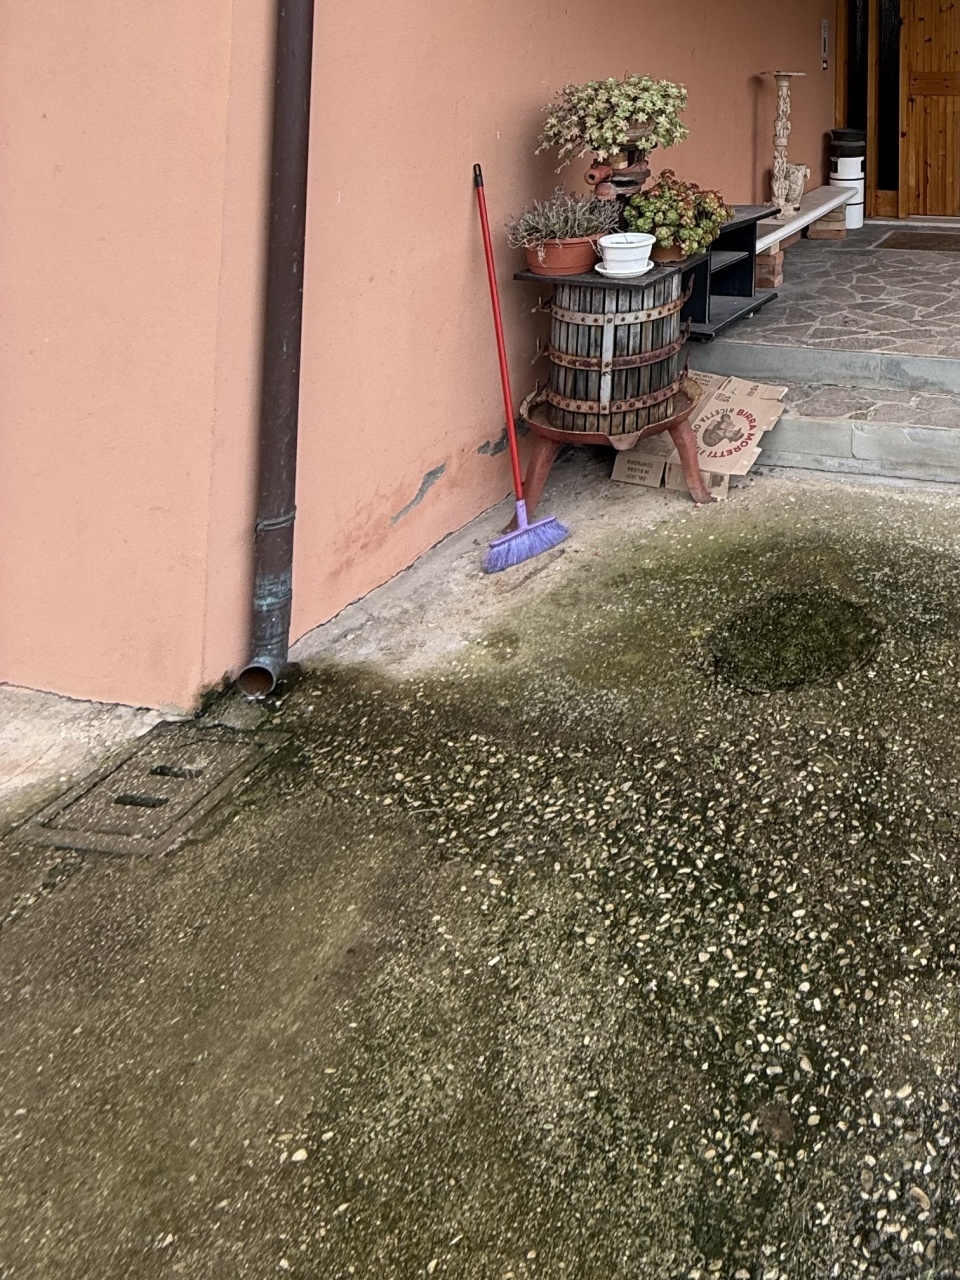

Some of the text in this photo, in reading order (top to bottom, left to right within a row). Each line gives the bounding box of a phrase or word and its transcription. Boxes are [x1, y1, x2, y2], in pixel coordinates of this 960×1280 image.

[700, 407, 735, 423] RICETTA
[707, 408, 757, 458] BIRRA MORETTI
